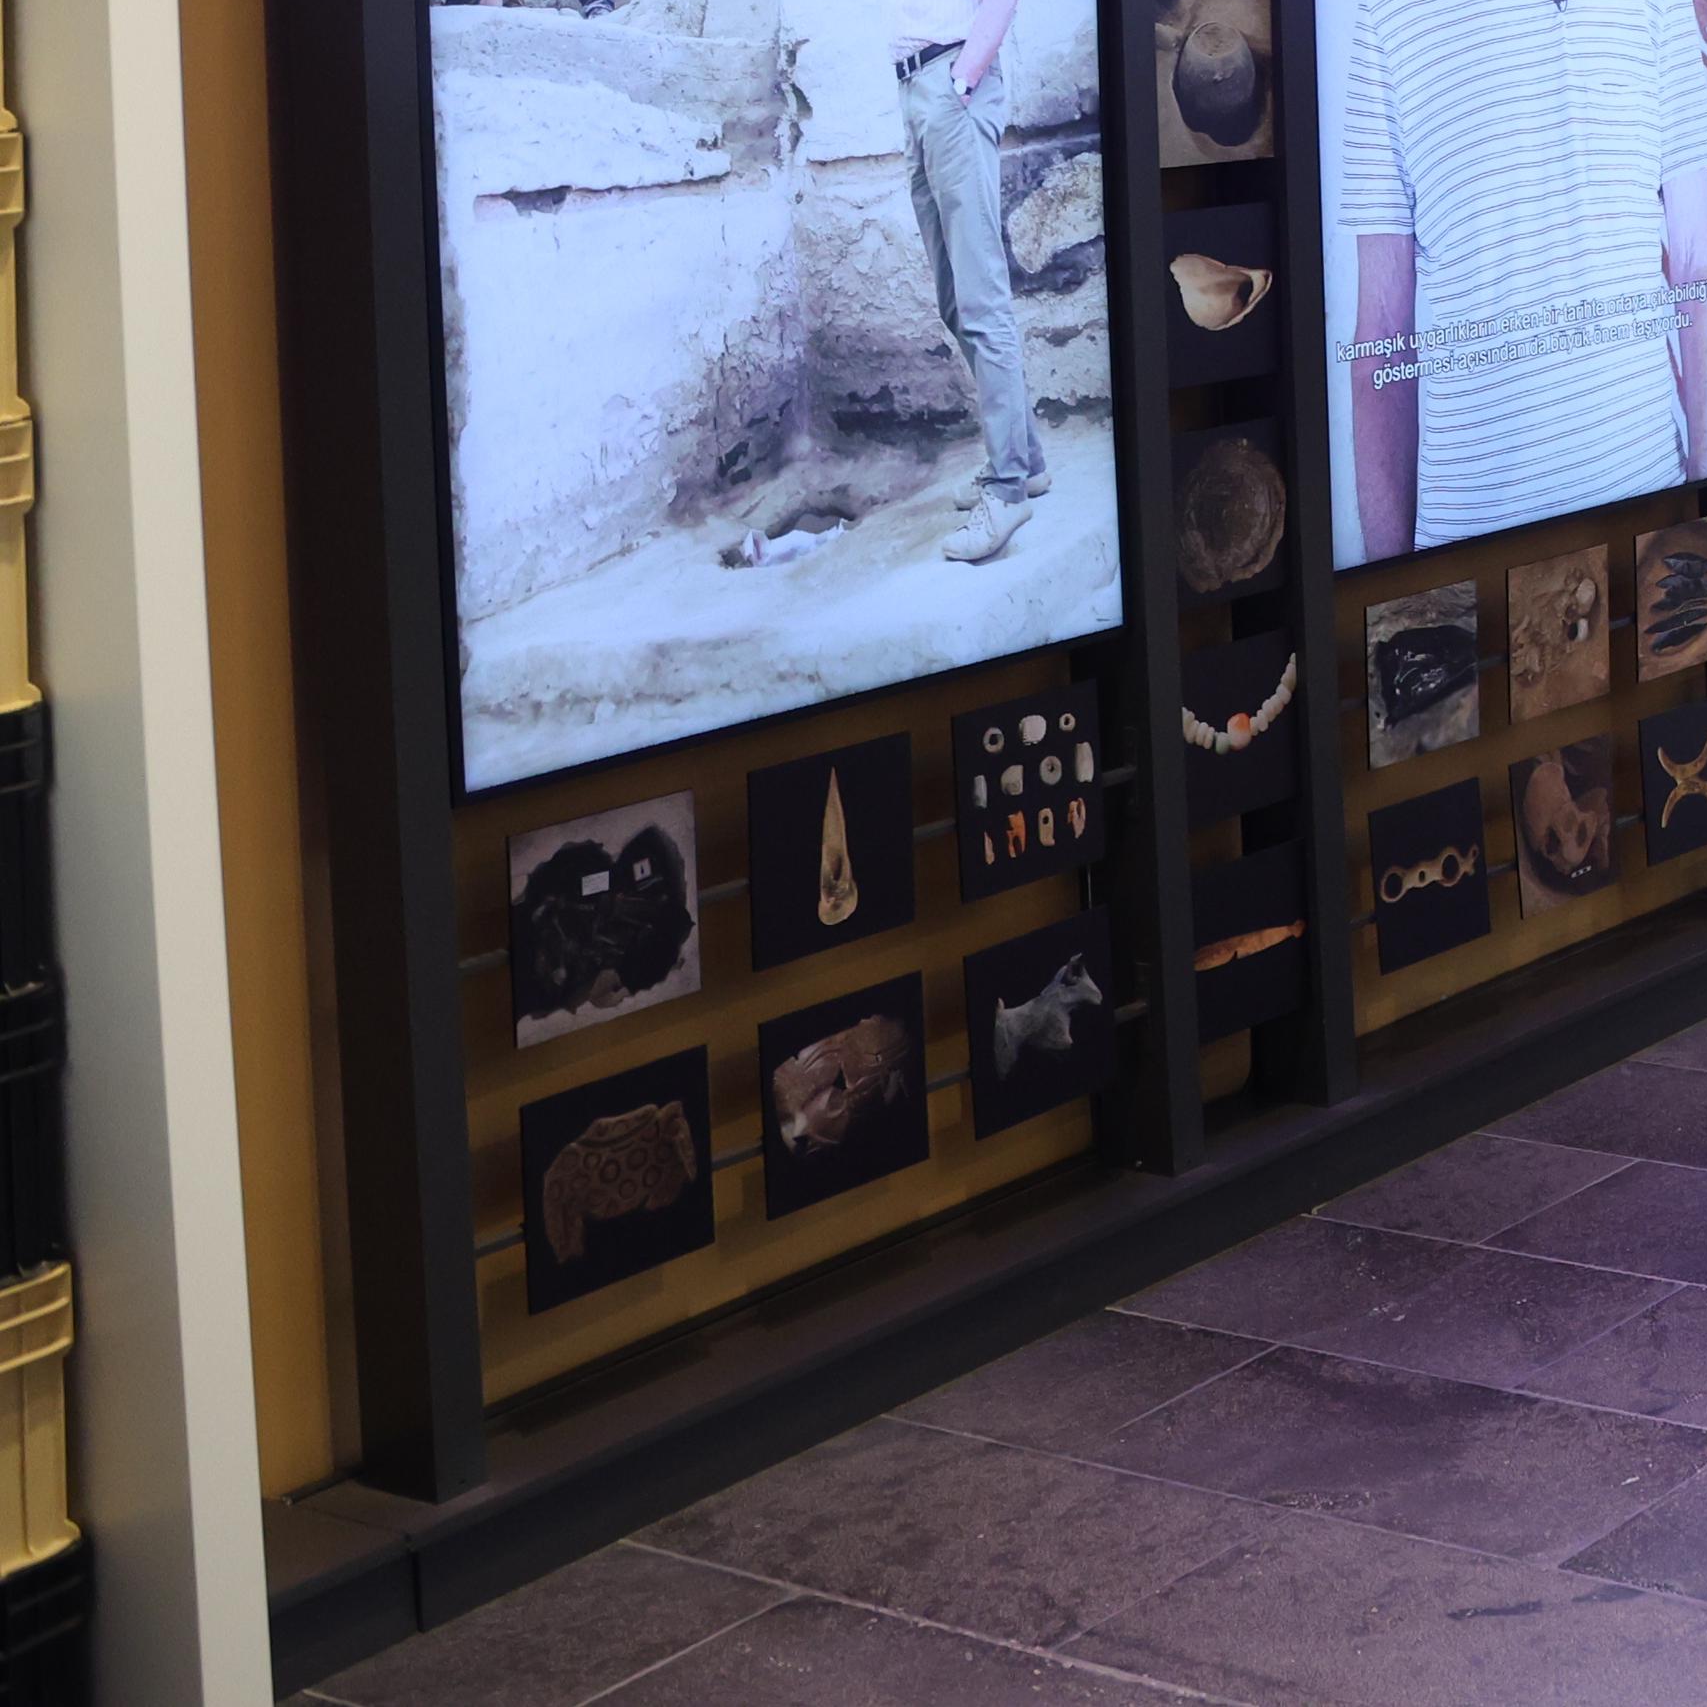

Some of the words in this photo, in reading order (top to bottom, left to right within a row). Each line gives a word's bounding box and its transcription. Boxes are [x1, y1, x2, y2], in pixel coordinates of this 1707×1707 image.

[1336, 332, 1406, 362] karmaşık
[1409, 318, 1497, 353] uygarlıkların
[1501, 310, 1540, 334] erken
[1542, 304, 1562, 325] bir
[1564, 299, 1603, 322] tarihte
[1604, 293, 1647, 316] ortaya
[1373, 349, 1454, 389] göstermesi
[1457, 339, 1527, 374] açısından
[1530, 337, 1546, 356] da
[1551, 326, 1590, 355] büyük
[1593, 320, 1630, 344] önem
[1632, 310, 1693, 340] taşıyordu.
